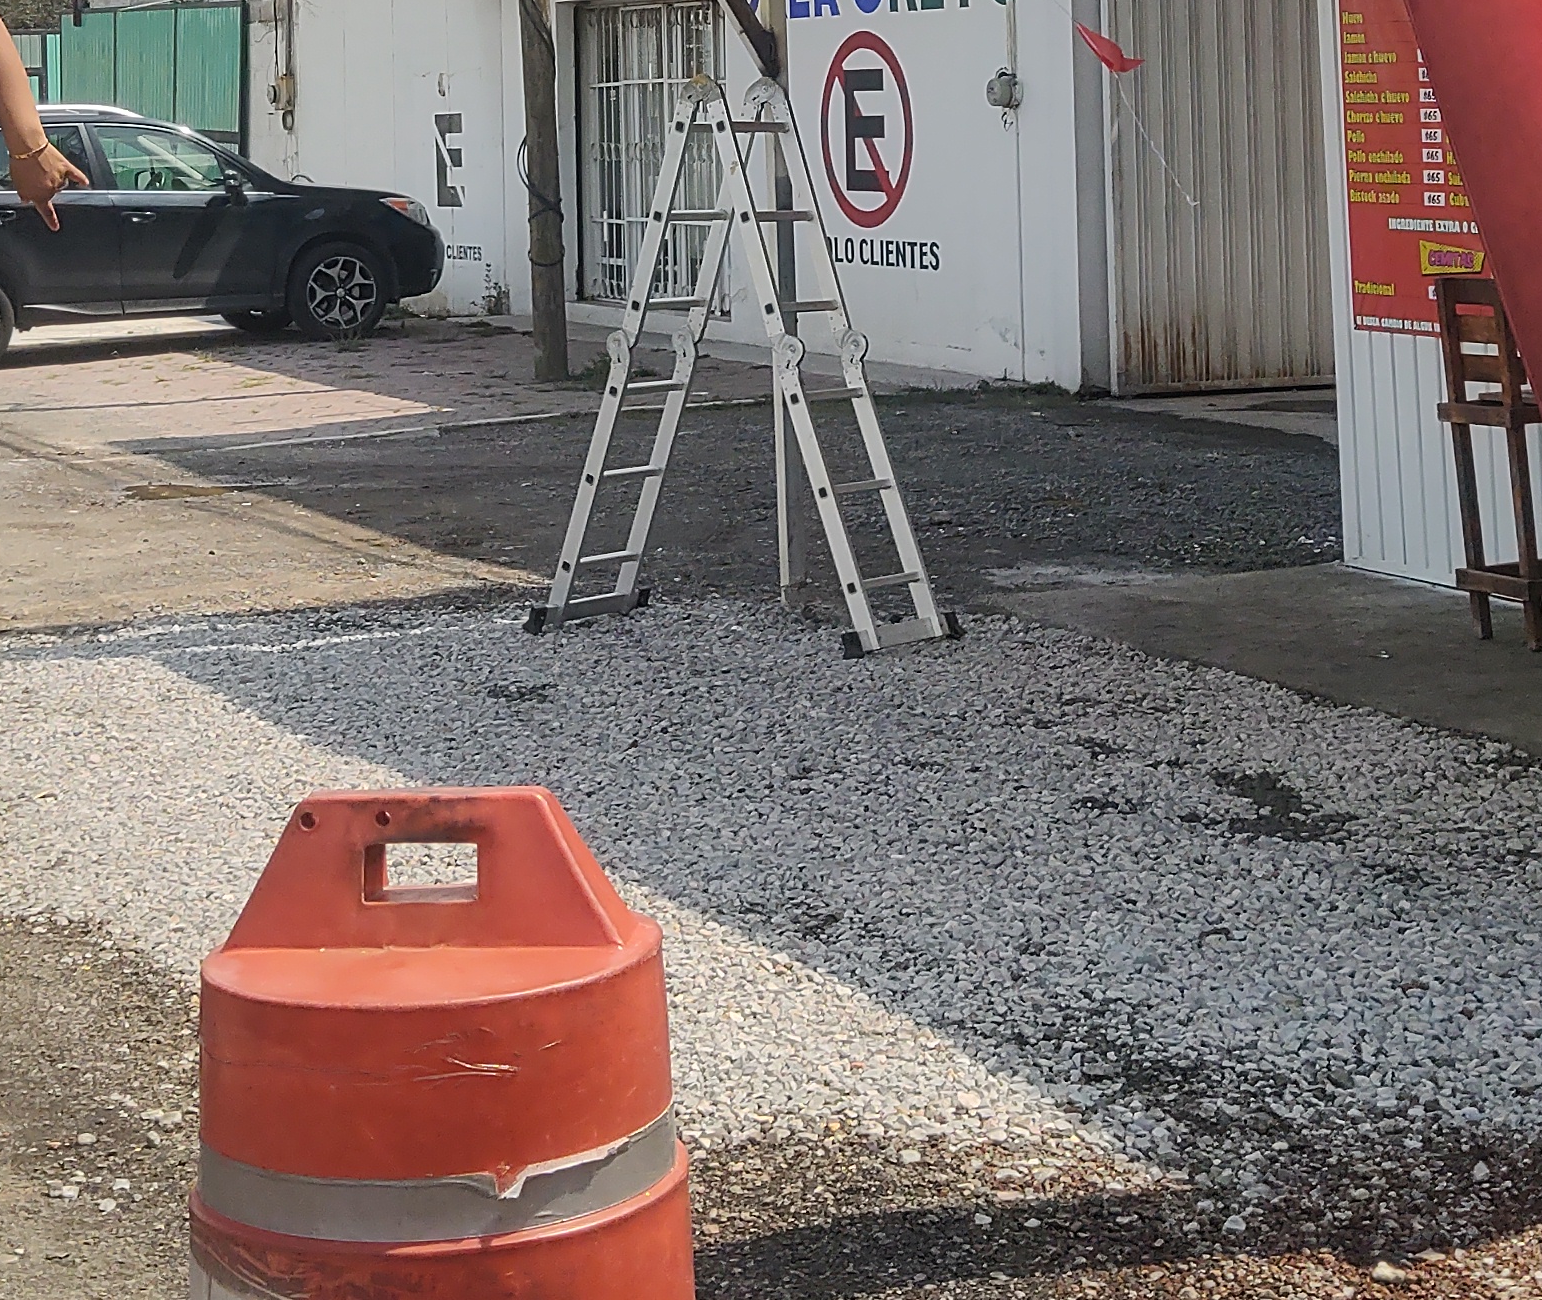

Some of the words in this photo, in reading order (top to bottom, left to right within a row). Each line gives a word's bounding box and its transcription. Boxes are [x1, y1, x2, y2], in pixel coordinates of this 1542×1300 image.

[1424, 110, 1437, 120] $65
[1347, 130, 1365, 143] Pollo
[1425, 131, 1438, 141] $65
[1348, 150, 1366, 163] Pollo
[1426, 151, 1439, 161] $65
[1427, 172, 1440, 182] $65
[1428, 194, 1441, 204] $65
[446, 245, 482, 261] CLIENTES
[860, 240, 940, 271] CLIENTES
[1355, 280, 1394, 295] Tradicional
